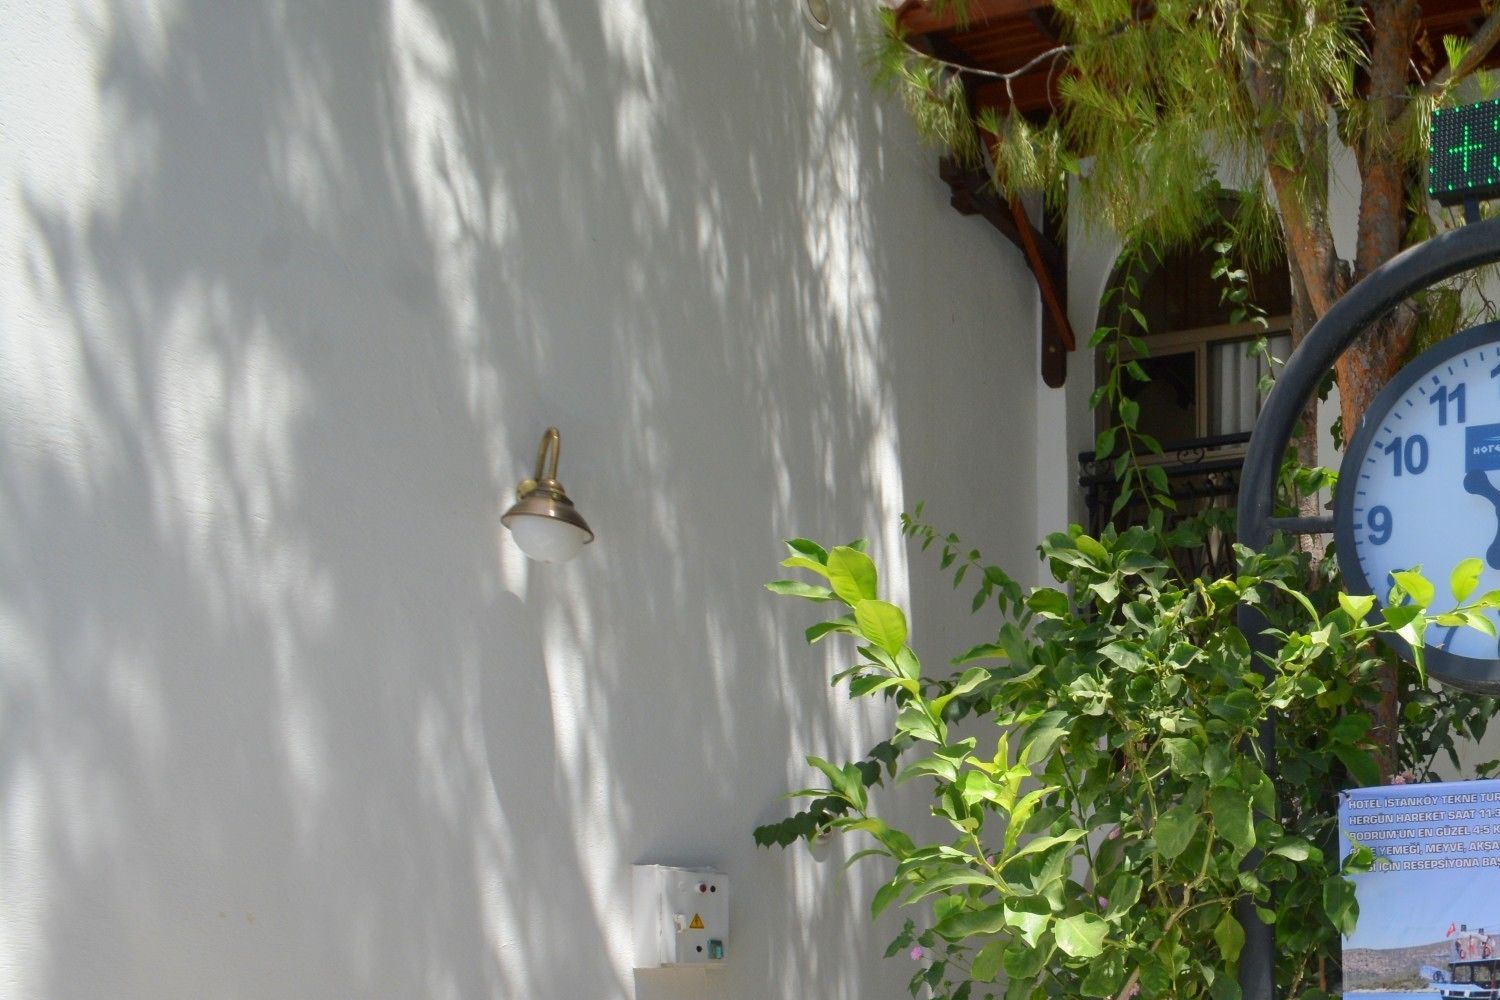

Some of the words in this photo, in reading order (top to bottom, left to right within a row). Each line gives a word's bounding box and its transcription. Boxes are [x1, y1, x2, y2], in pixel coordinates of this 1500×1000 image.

[1429, 383, 1466, 426] 11
[1385, 434, 1429, 477] 10
[1367, 505, 1393, 545] 9
[1348, 799, 1382, 810] HOTEL
[1441, 793, 1477, 804] TEKNE
[1396, 811, 1446, 823] HAREKET
[1448, 809, 1476, 820] SAAT
[1349, 828, 1416, 841] BODRUM'UN
[1418, 828, 1432, 838] EN
[1436, 825, 1471, 837] GÜZEL
[1472, 824, 1490, 834] 4-5
[1425, 842, 1466, 853] MEYVE,
